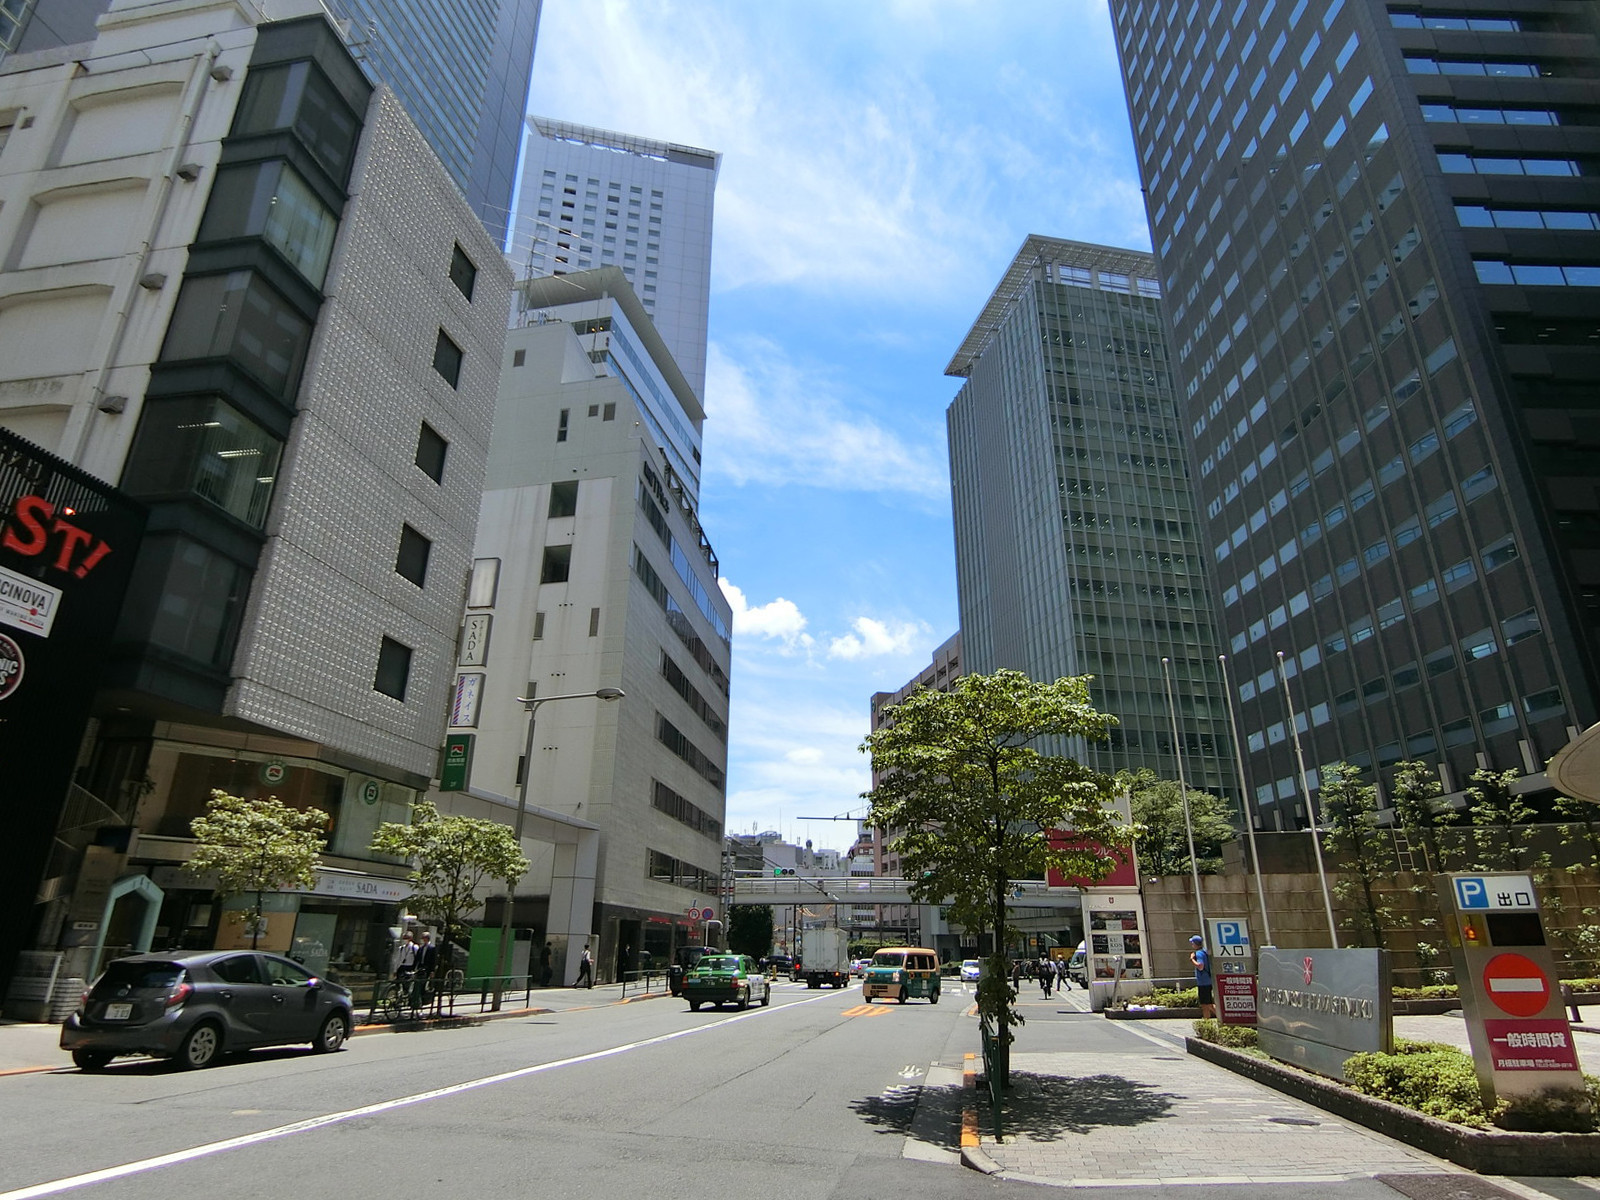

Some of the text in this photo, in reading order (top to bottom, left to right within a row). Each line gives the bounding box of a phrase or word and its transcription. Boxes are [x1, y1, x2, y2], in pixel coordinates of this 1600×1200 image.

[3, 494, 112, 579] ST!
[0, 580, 46, 610] CINOVA
[466, 620, 478, 661] SADA
[355, 882, 378, 895] SADA
[1497, 892, 1530, 906] 出口
[1220, 946, 1244, 956] 入口
[1226, 1002, 1254, 1010] 2,000円
[1493, 1032, 1567, 1048] 一般時間貸
